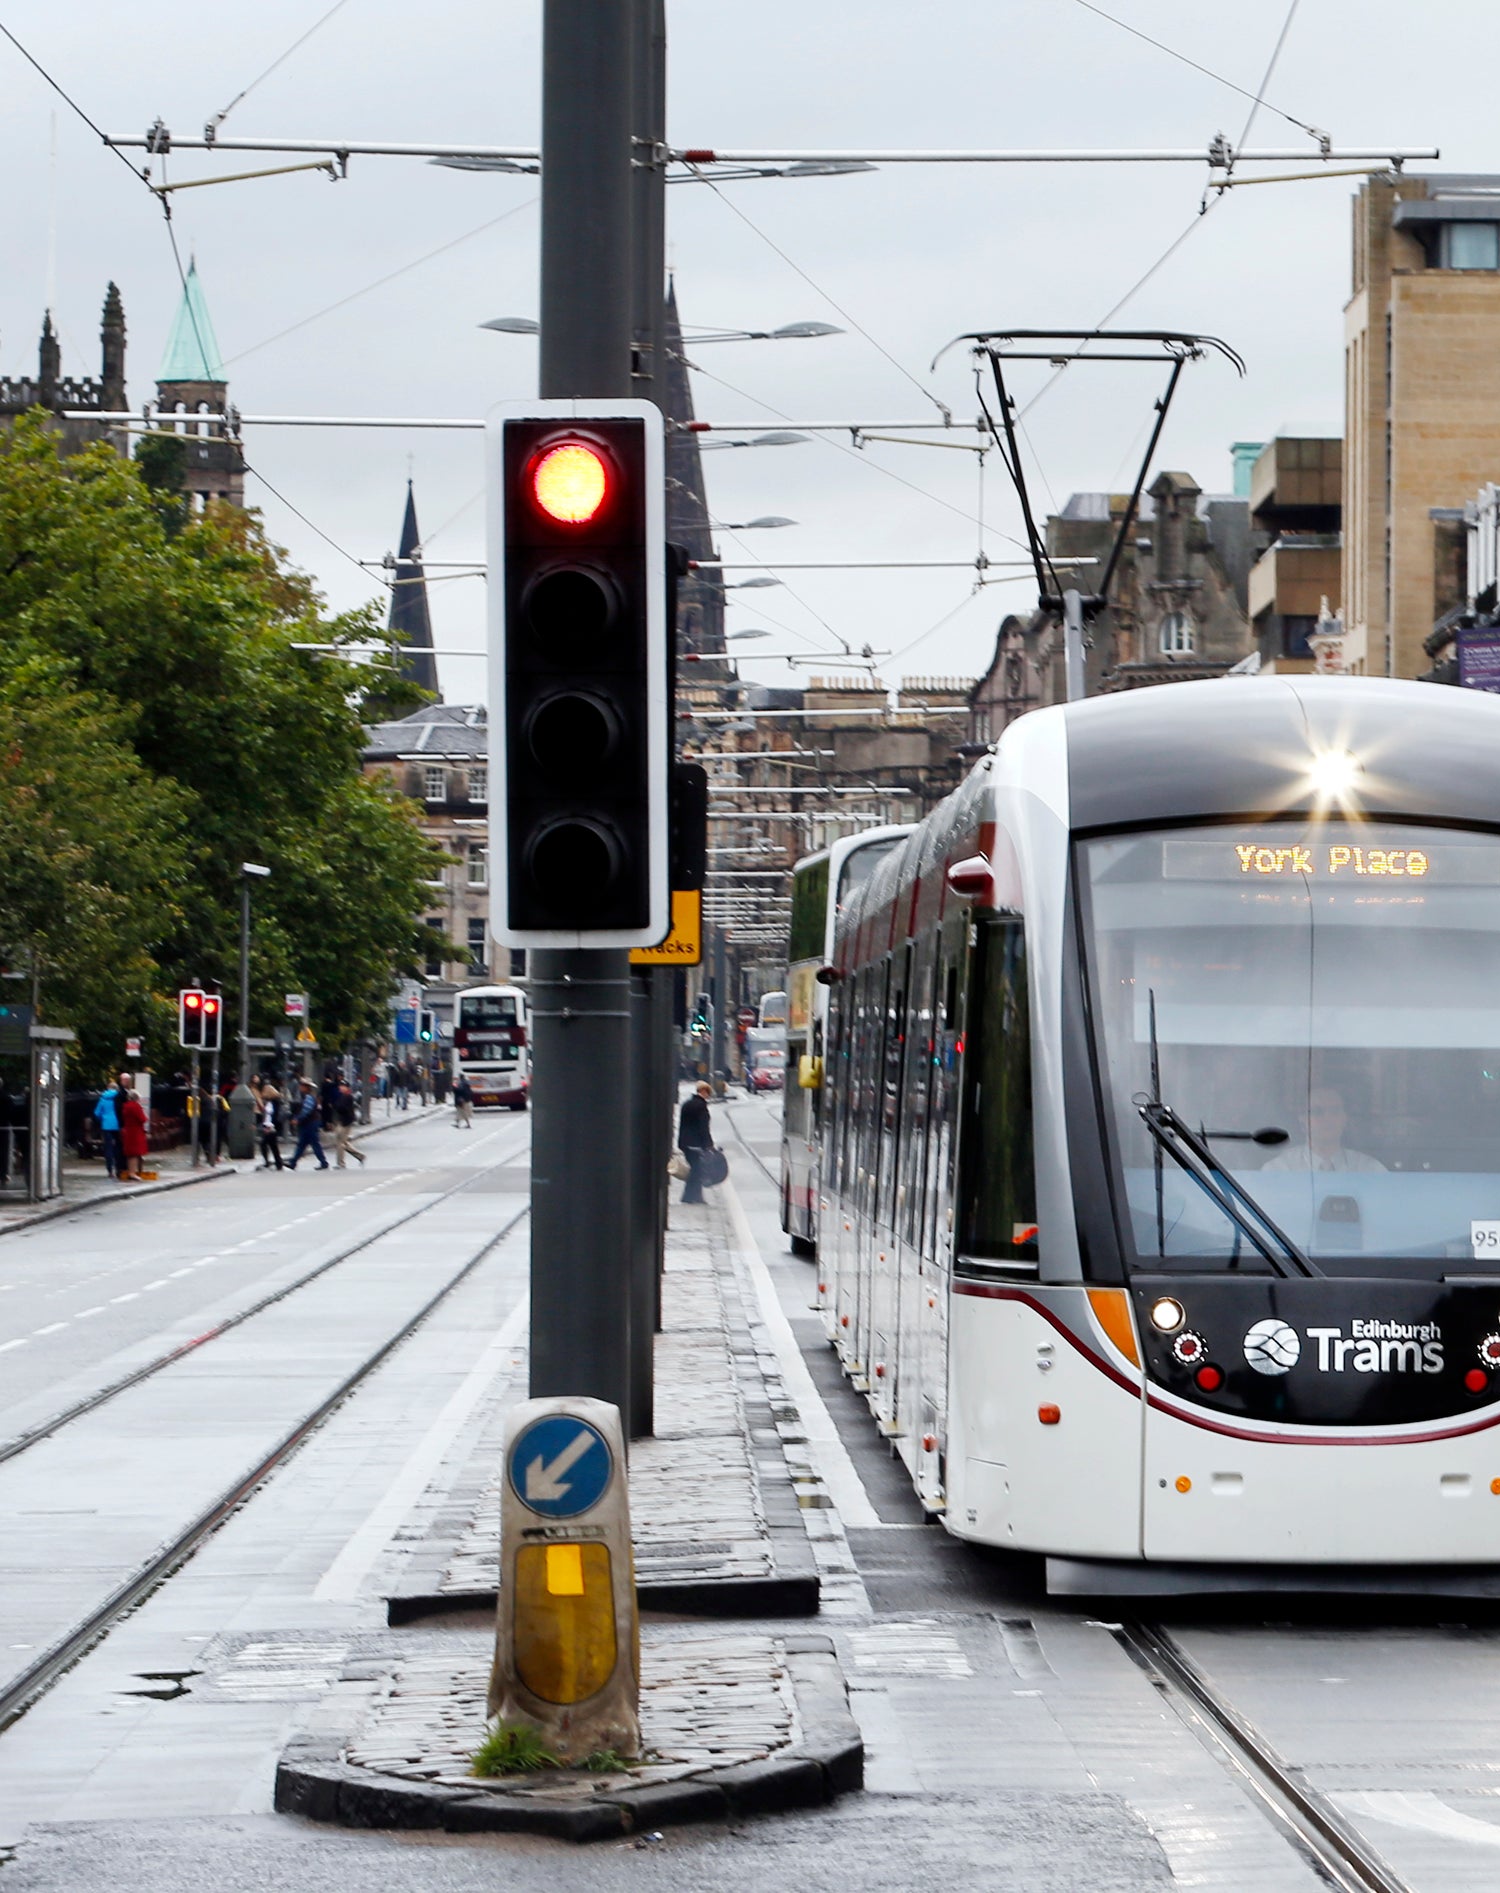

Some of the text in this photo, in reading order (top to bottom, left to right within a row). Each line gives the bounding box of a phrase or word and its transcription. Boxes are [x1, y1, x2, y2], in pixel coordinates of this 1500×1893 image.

[1234, 844, 1429, 876] York Place
[1352, 1318, 1441, 1342] Edinburgh
[1306, 1327, 1445, 1374] Trams
